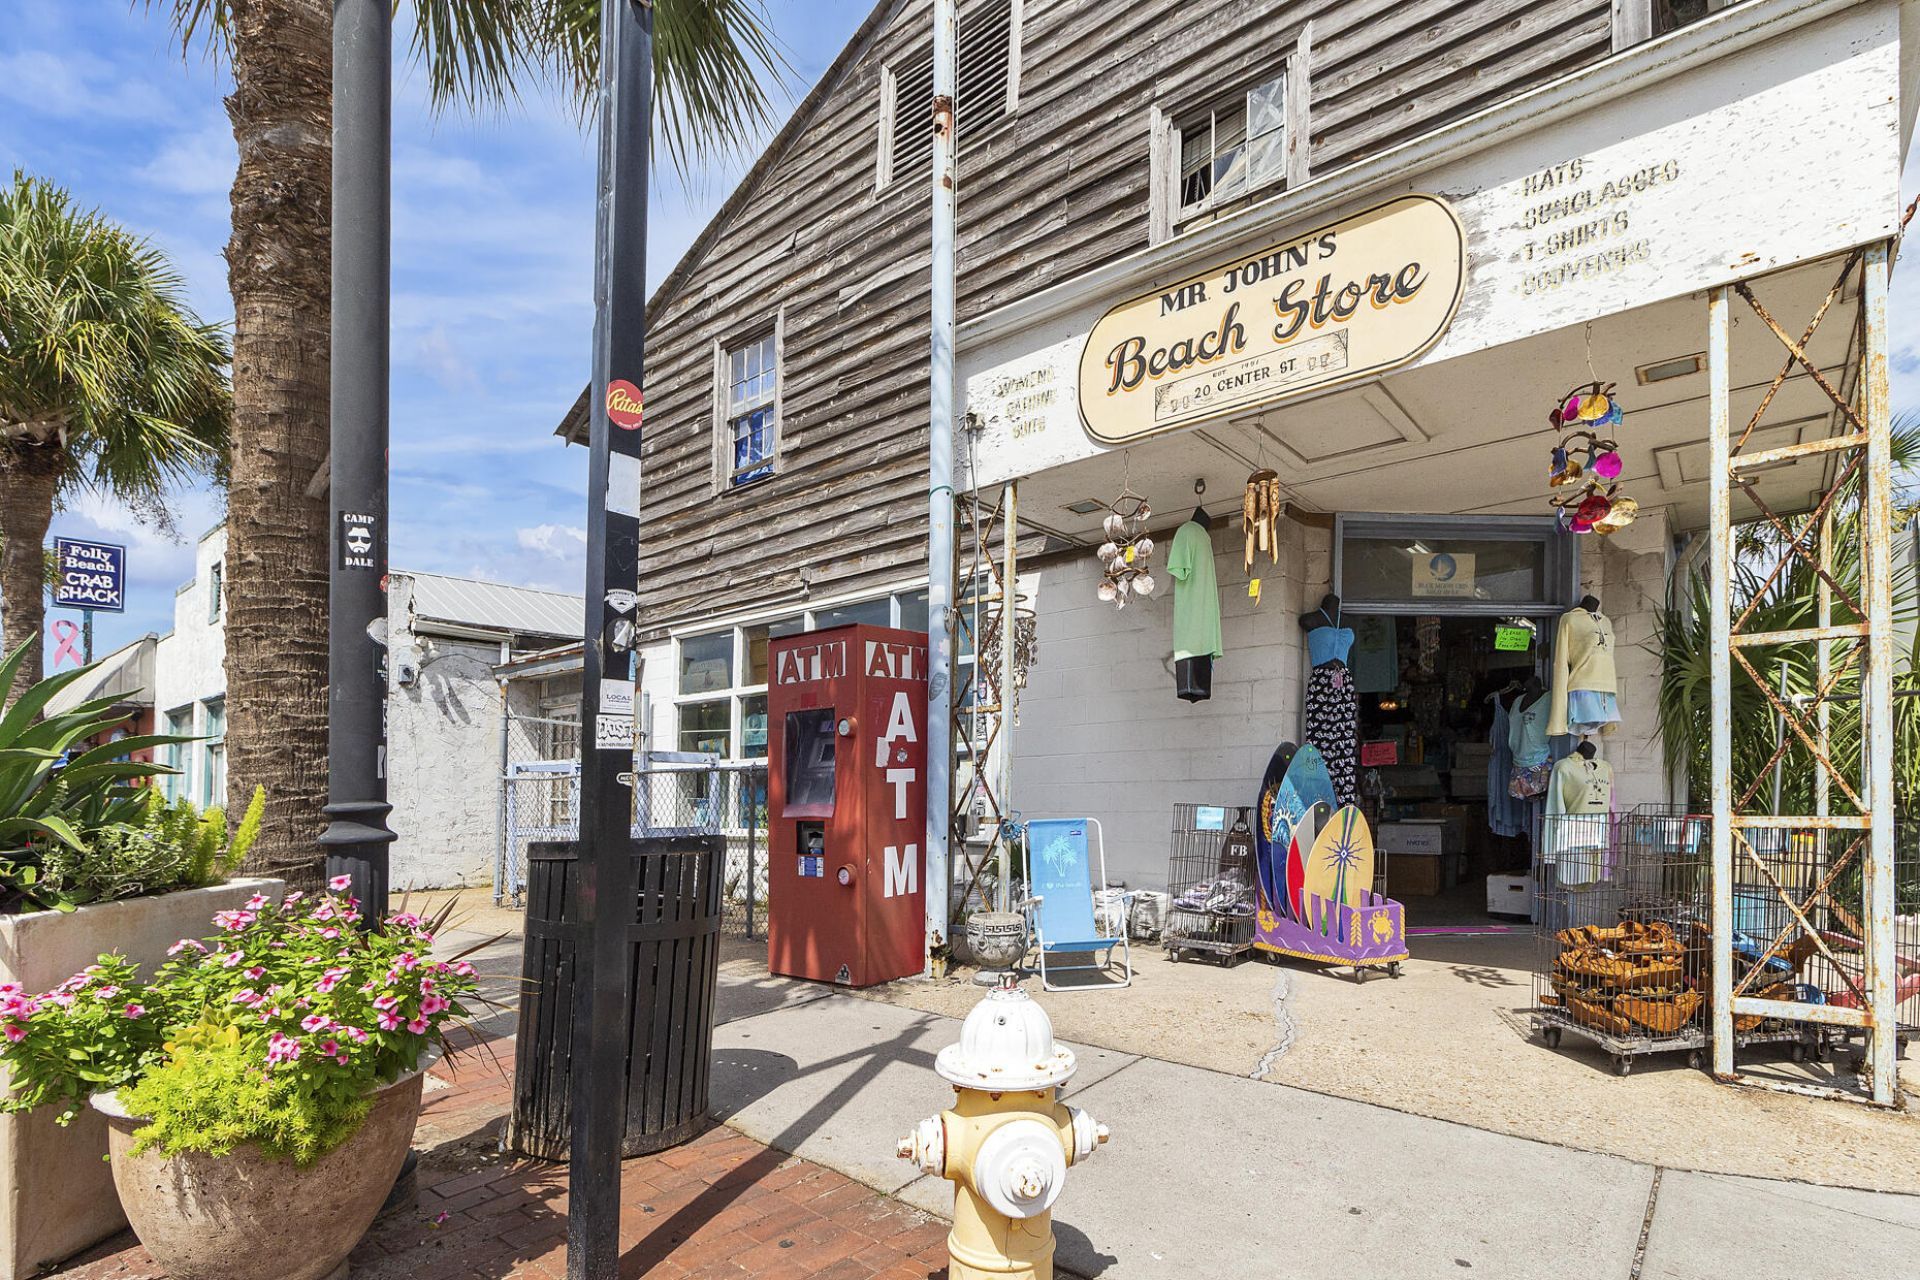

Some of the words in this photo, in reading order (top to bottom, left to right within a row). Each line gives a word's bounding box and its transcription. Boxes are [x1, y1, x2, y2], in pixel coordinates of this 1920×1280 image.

[1523, 158, 1583, 197] HATS
[1524, 159, 1680, 230] SUNGLASSES
[1524, 210, 1629, 261] T-SHIRTS
[1160, 281, 1211, 317] MR.
[1223, 231, 1337, 294] JOHN'S
[1106, 301, 1248, 396] Beach
[1271, 261, 1430, 344] Store
[1193, 384, 1211, 399] 20
[1217, 366, 1271, 393] CENTER
[606, 388, 643, 415] Rita's
[343, 513, 375, 525] CAMP
[65, 556, 116, 573] Beach
[69, 545, 112, 562] Folly
[345, 556, 374, 568] DALE
[59, 585, 120, 604] SHACK
[65, 572, 114, 589] CRAB
[779, 642, 845, 686] ATM
[867, 642, 928, 682] ATM
[606, 693, 632, 702] LOCAL
[884, 692, 917, 899] ATM
[1230, 844, 1248, 857] FB
